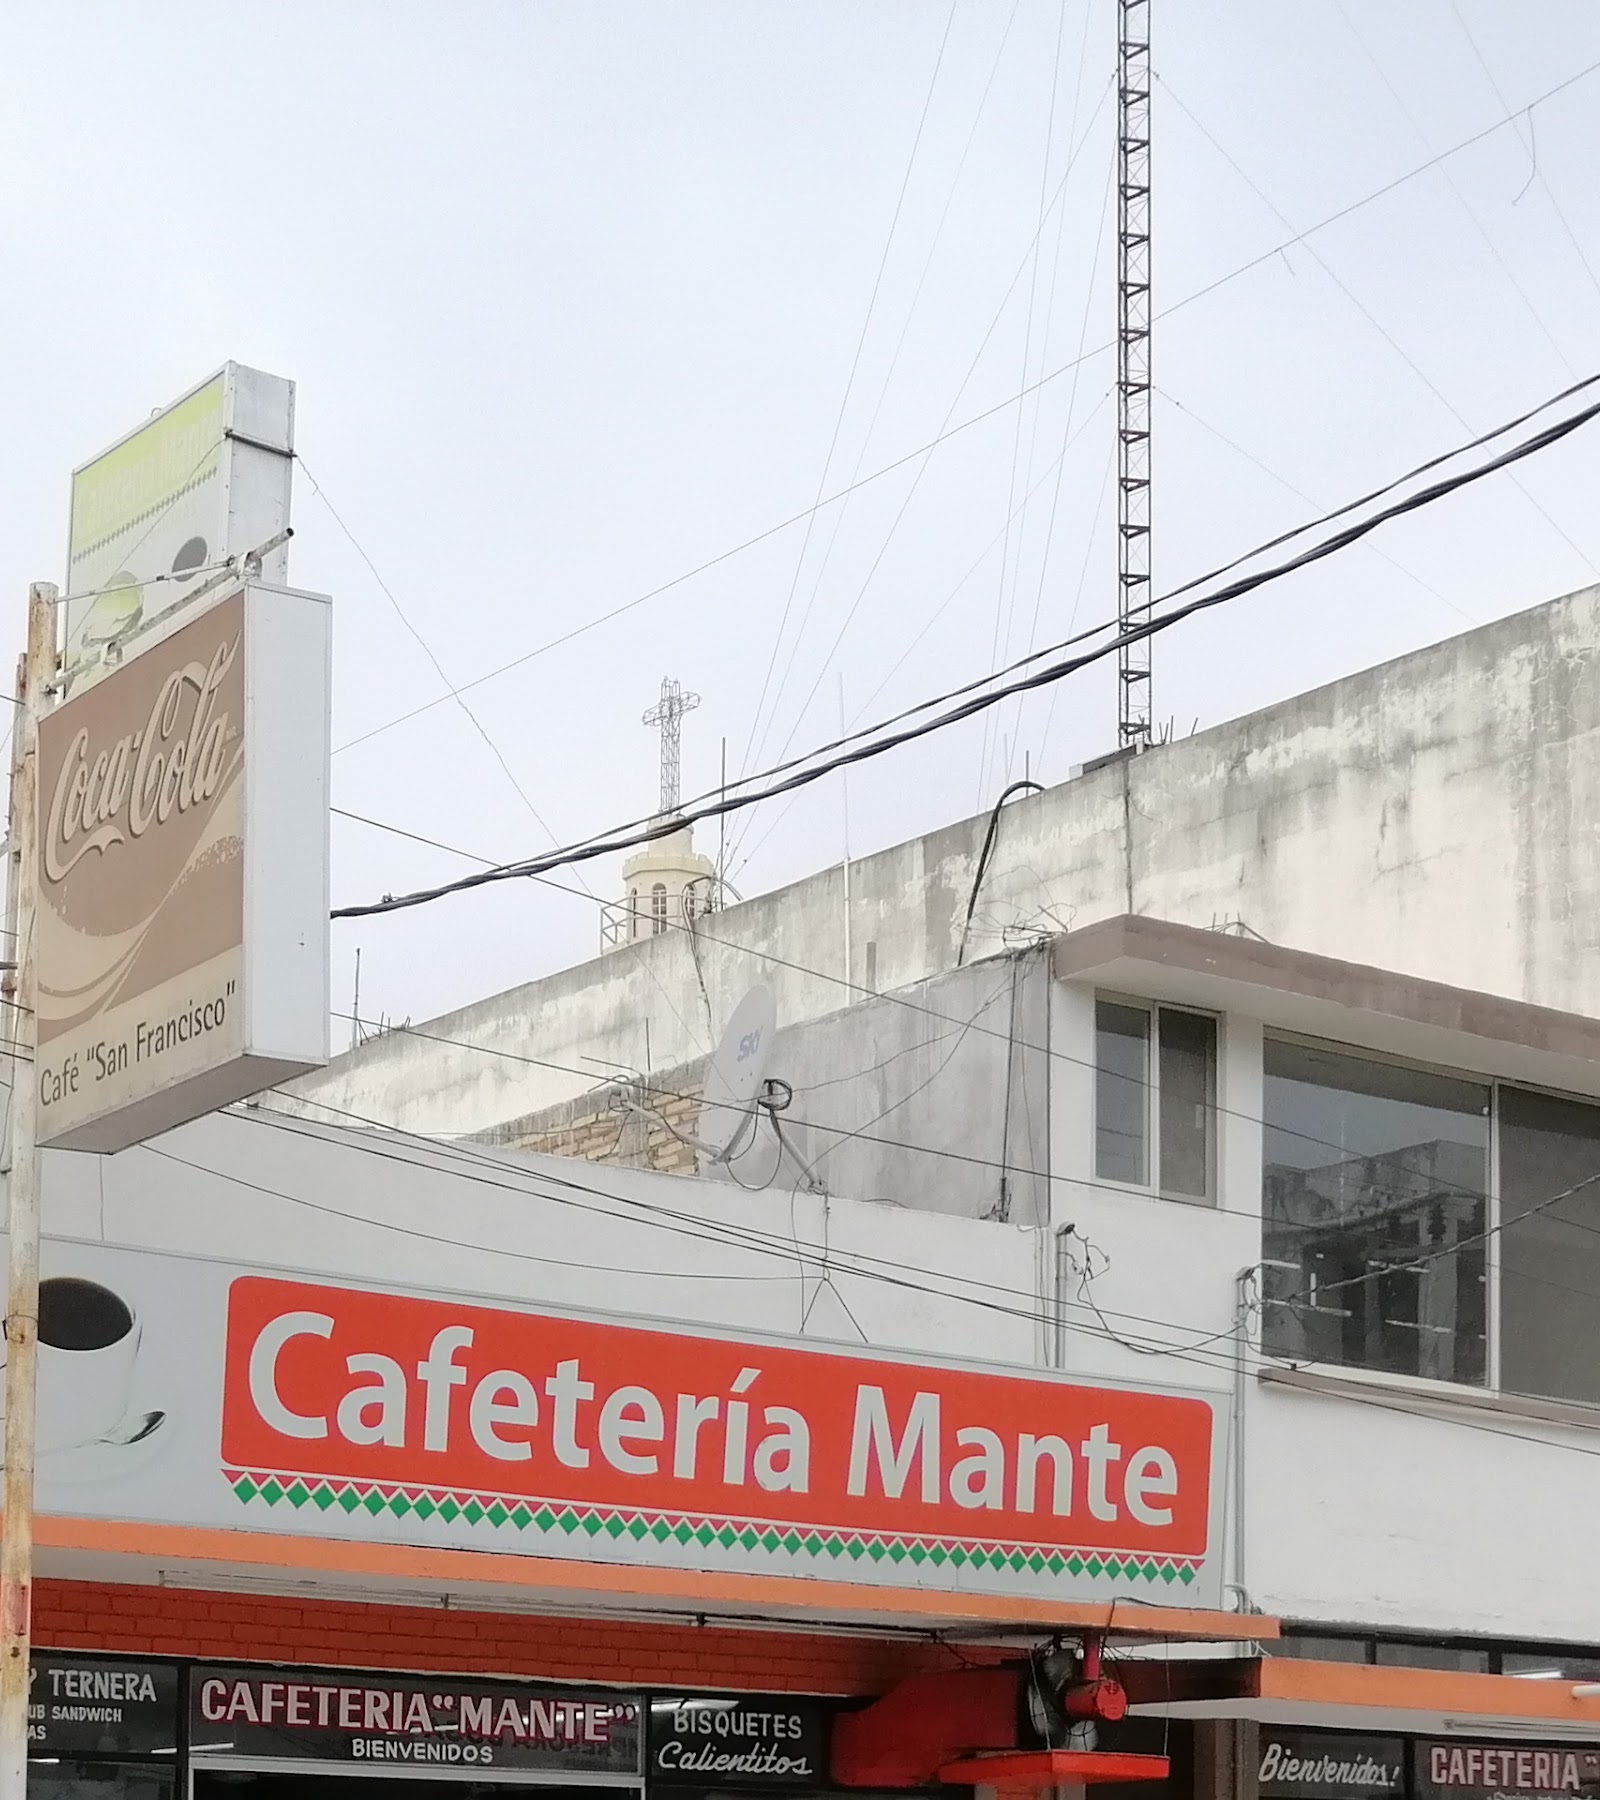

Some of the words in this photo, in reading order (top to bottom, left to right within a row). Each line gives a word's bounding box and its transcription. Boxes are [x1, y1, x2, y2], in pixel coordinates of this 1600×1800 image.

[45, 629, 242, 882] Coca-Cola
[40, 1052, 80, 1106] Café
[87, 1041, 128, 1081] "San
[136, 979, 236, 1062] Francisco"
[248, 1310, 810, 1493] Cafetería
[846, 1383, 1179, 1527] Mante
[48, 1668, 158, 1703] TERNERA
[200, 1678, 434, 1734] CAFETERIA
[51, 1706, 122, 1723] SANDWICH
[672, 1709, 802, 1739] BISQUETES
[352, 1738, 493, 1763] BIENVENIDOS
[658, 1741, 813, 1775] Calientitos
[1257, 1742, 1400, 1788] Bienvenidos!
[1430, 1746, 1580, 1791] CAFETERIA
